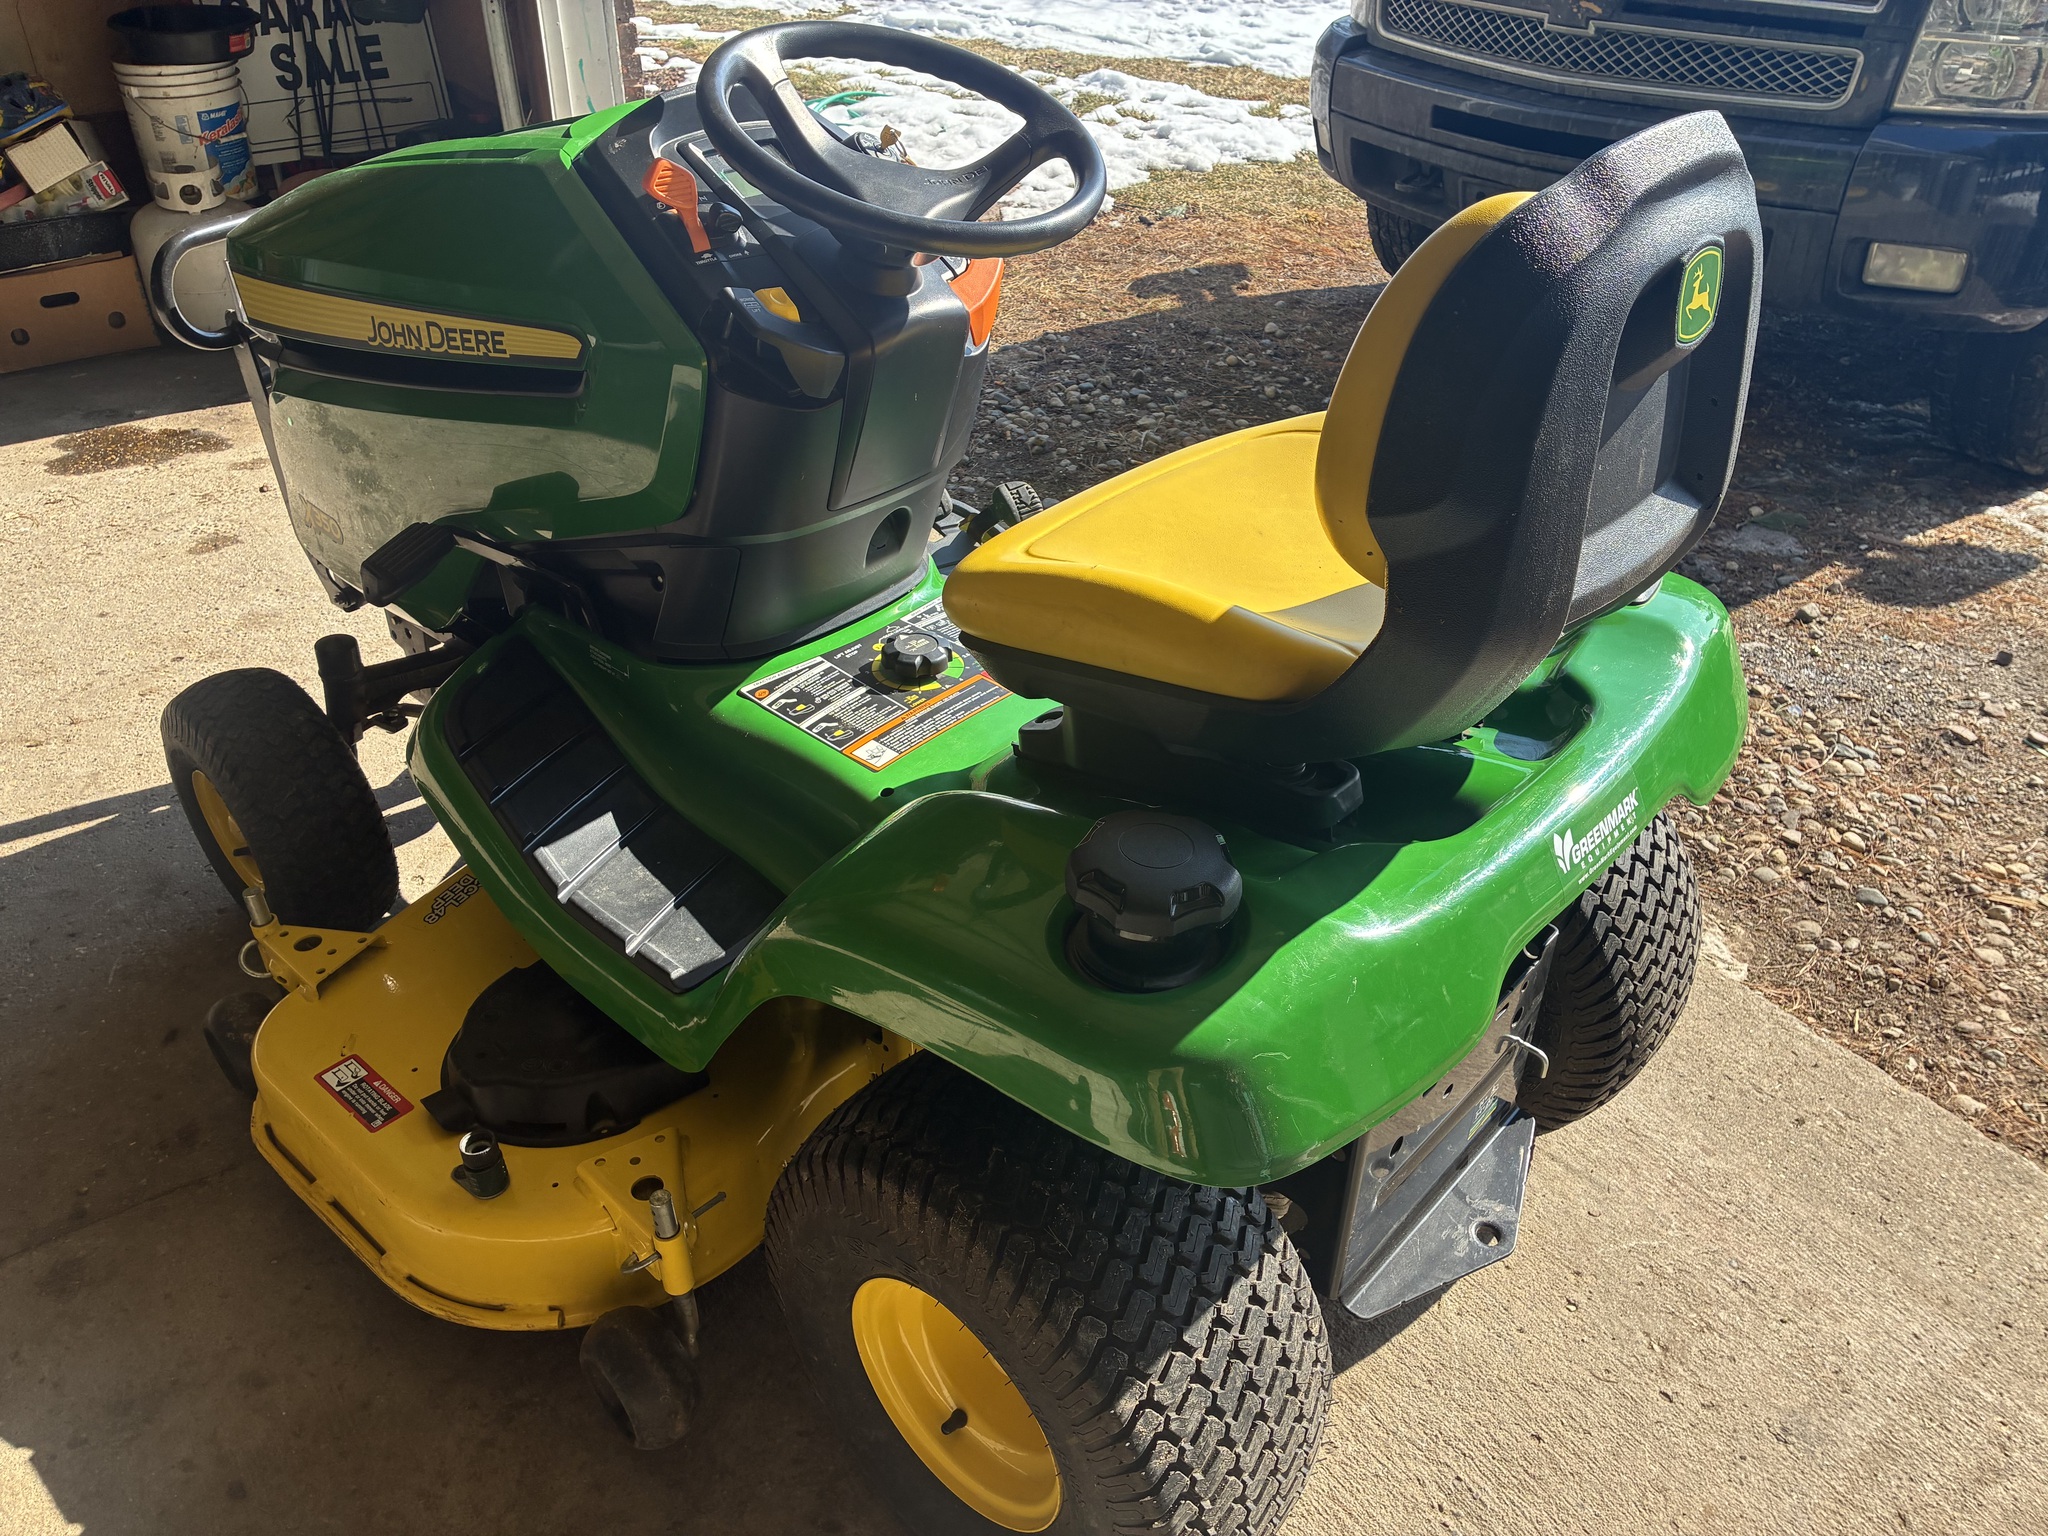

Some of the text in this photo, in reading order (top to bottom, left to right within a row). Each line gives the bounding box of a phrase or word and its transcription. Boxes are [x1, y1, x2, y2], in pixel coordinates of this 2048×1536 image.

[270, 34, 390, 91] SALE
[99, 173, 114, 194] RIVAL
[367, 315, 510, 358] JOHN DEERE
[1571, 790, 1639, 864] GREENMARK
[1580, 811, 1637, 869] EQUIPMENT
[431, 873, 477, 911] DEEP
[359, 1082, 392, 1111] ROTATING BLADE
[378, 1082, 401, 1103] DANGER
